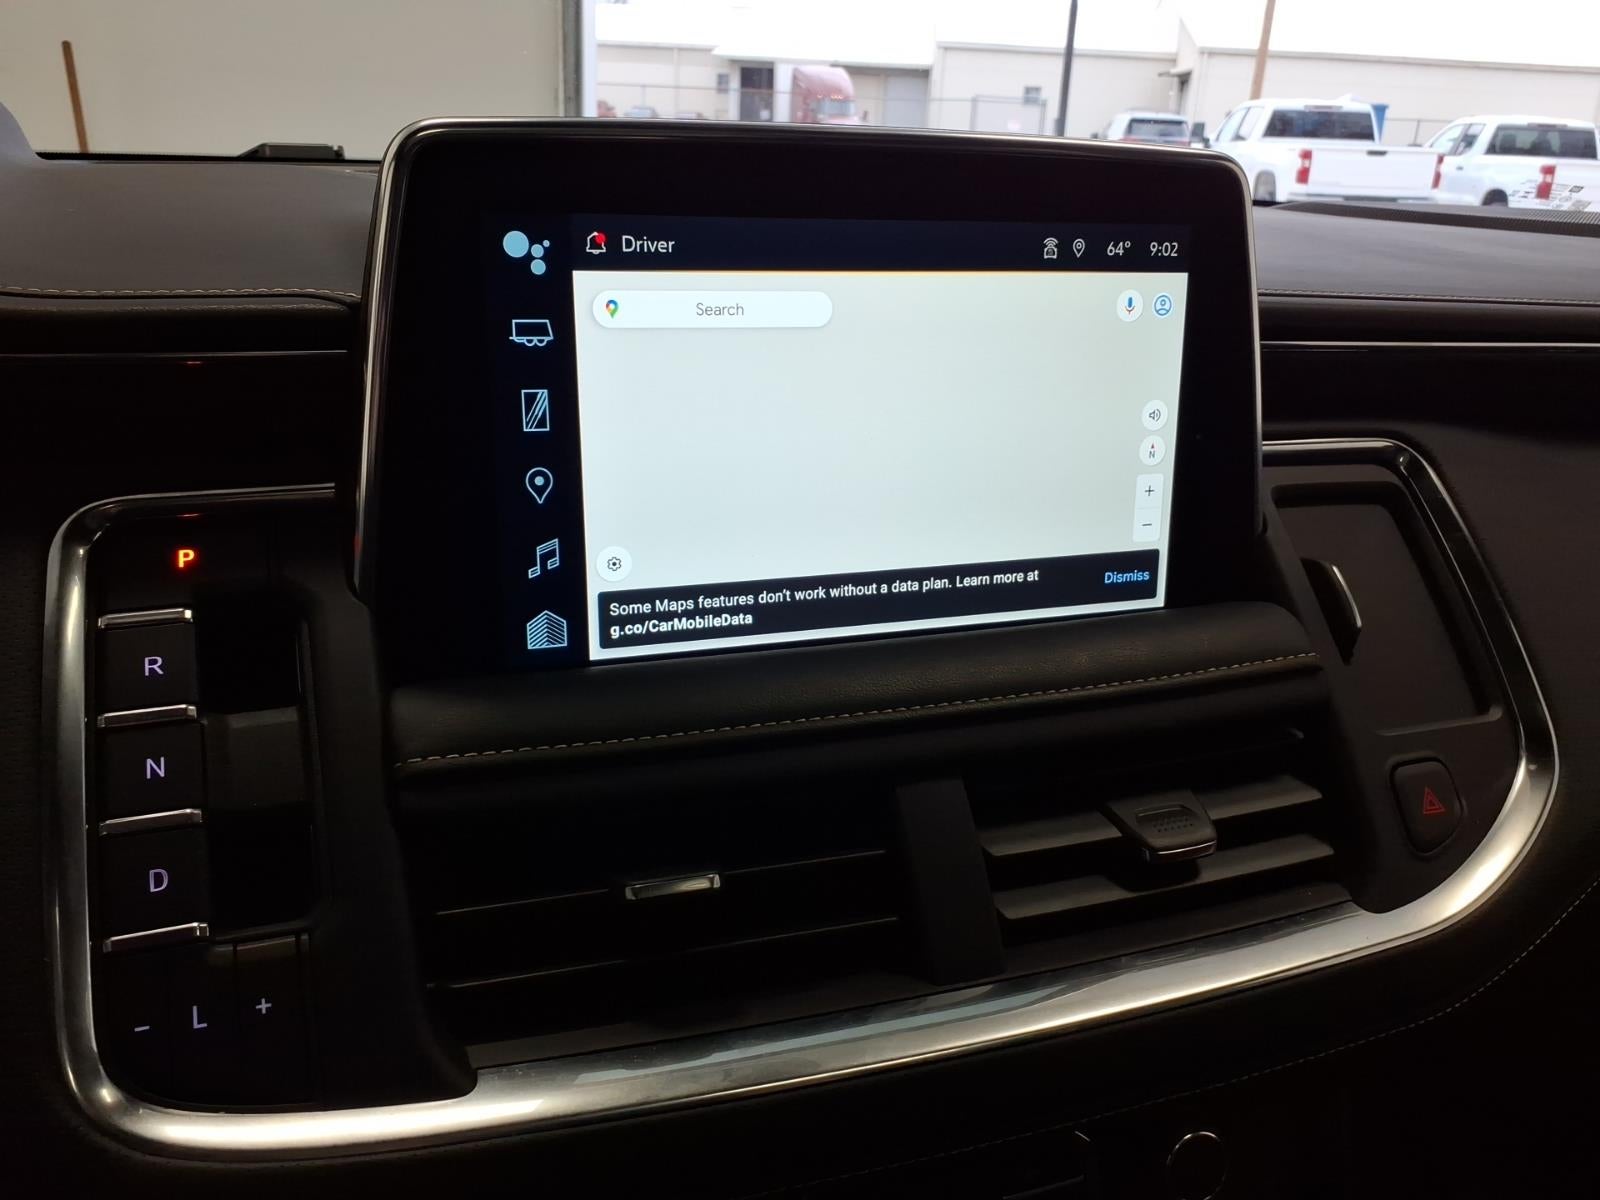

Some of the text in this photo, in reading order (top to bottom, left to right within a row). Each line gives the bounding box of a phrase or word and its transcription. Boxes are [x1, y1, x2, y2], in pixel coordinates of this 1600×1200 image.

[621, 234, 676, 254] Driver
[1106, 241, 1132, 257] 64°
[1149, 241, 1179, 258] 9:02
[695, 302, 745, 318] Search
[177, 548, 196, 569] P
[1103, 569, 1151, 584] Dismiss
[609, 569, 1040, 616] Some Maps features don't work without a data plan. Learn more at
[609, 612, 753, 639] g.co/CarMobileData
[143, 655, 165, 677] R
[145, 756, 166, 780] N
[149, 867, 170, 893] D
[191, 1004, 209, 1030] L
